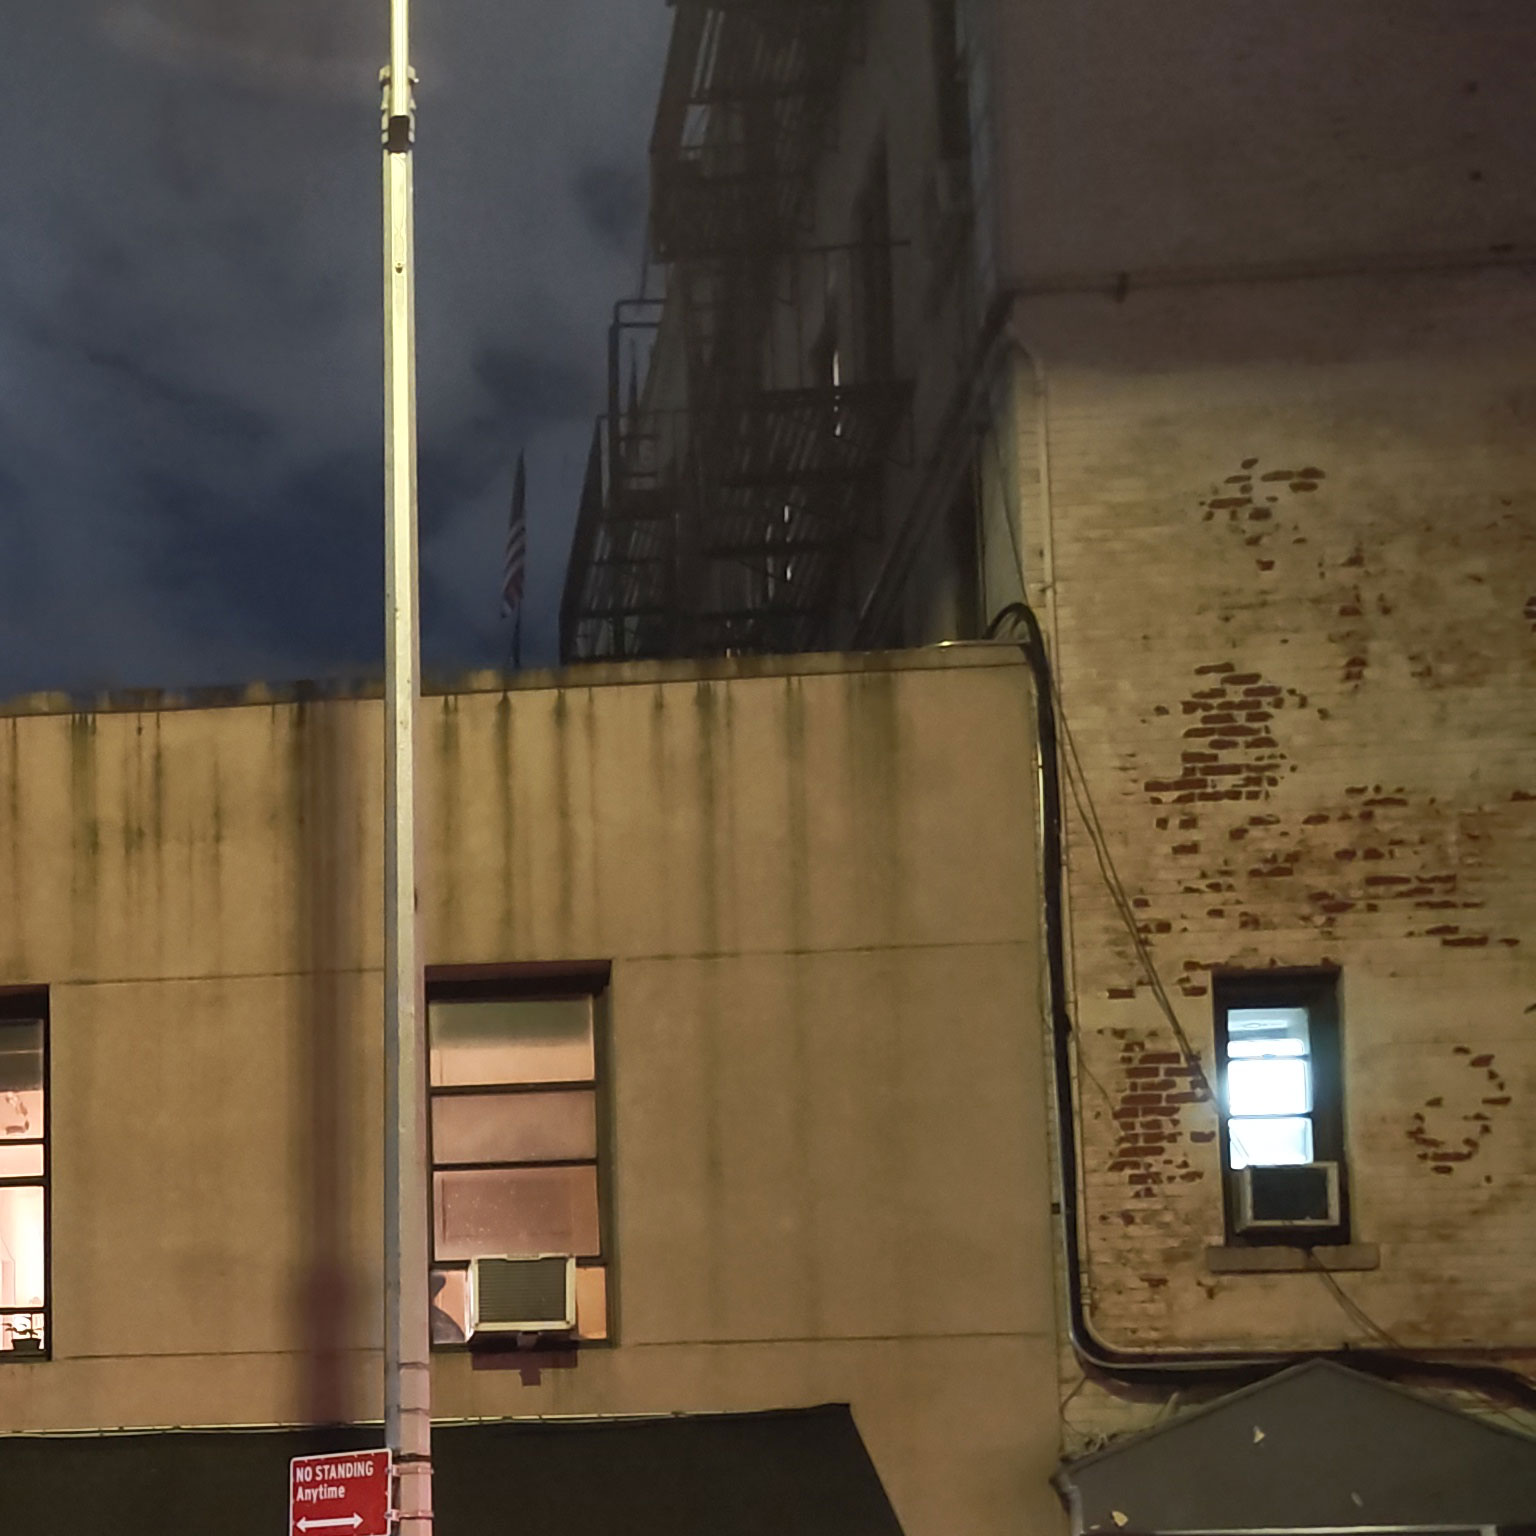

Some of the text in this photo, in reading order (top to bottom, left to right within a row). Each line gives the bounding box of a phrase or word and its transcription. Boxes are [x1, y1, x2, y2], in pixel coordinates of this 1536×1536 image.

[296, 1461, 374, 1483] NO STANDING
[296, 1484, 345, 1503] Anytime
